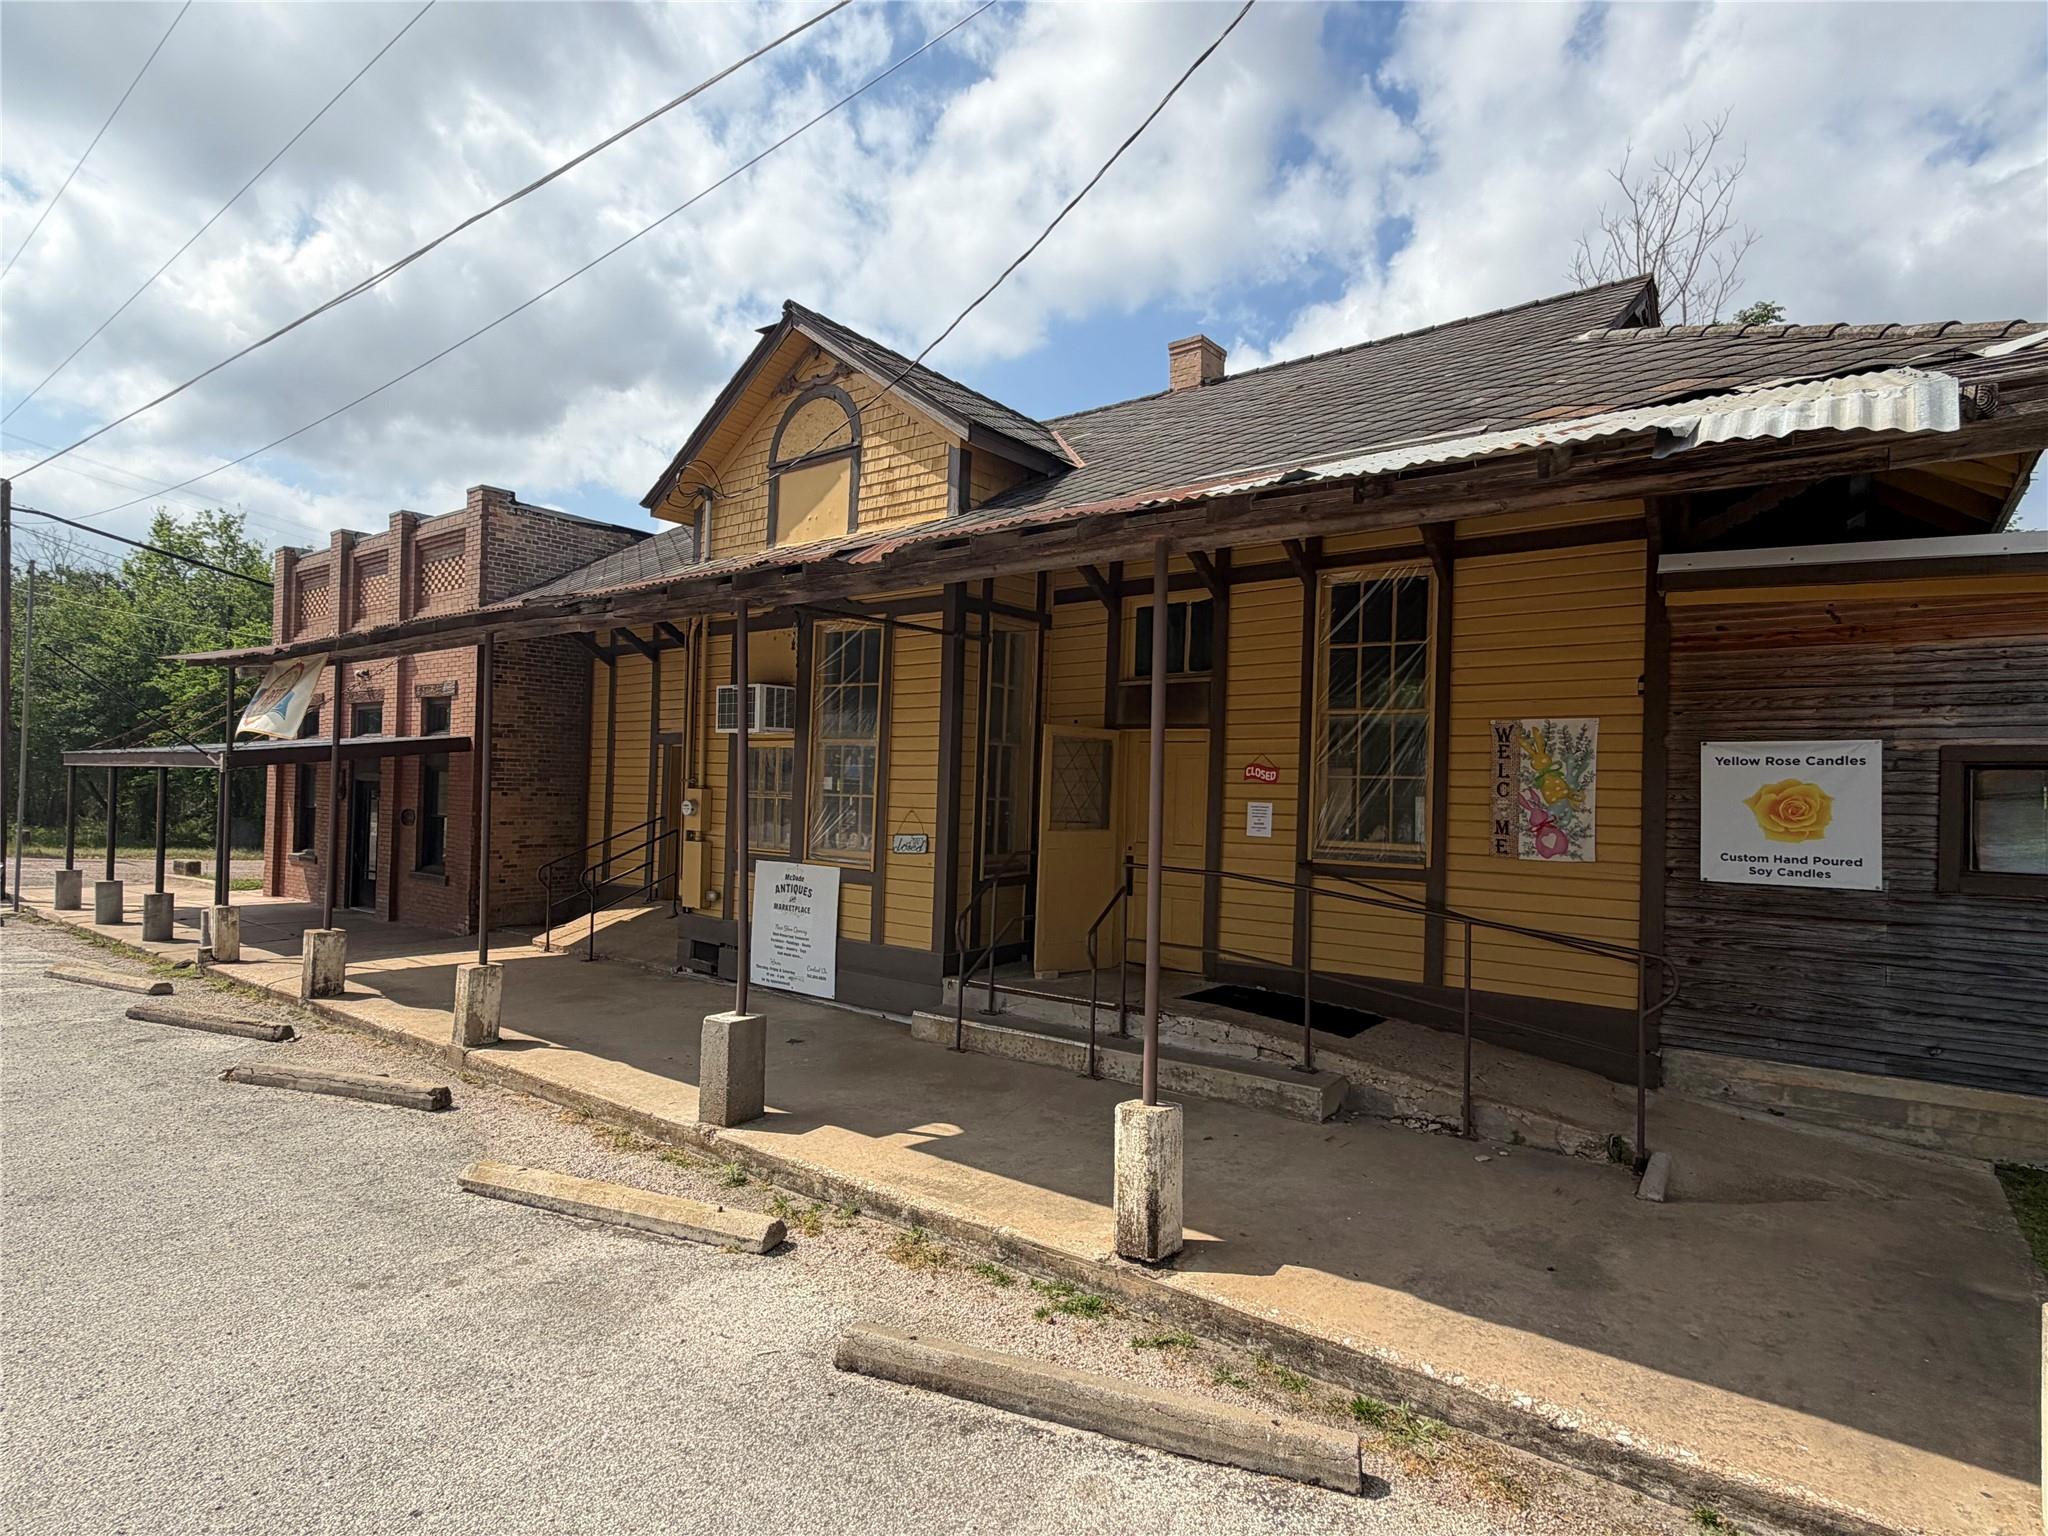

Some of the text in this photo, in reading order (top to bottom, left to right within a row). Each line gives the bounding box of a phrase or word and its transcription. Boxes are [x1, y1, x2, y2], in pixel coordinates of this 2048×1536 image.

[1714, 755, 1867, 767] Yellow Rose Candles
[1245, 766, 1277, 781] CLOSED
[895, 838, 928, 853] losed
[1720, 852, 1863, 867] Custom Hand Poured
[784, 873, 805, 882] McDade
[1748, 866, 1832, 879] Soy Candles
[775, 883, 813, 898] ANTIQUES
[773, 902, 811, 914] MARKETPLACE
